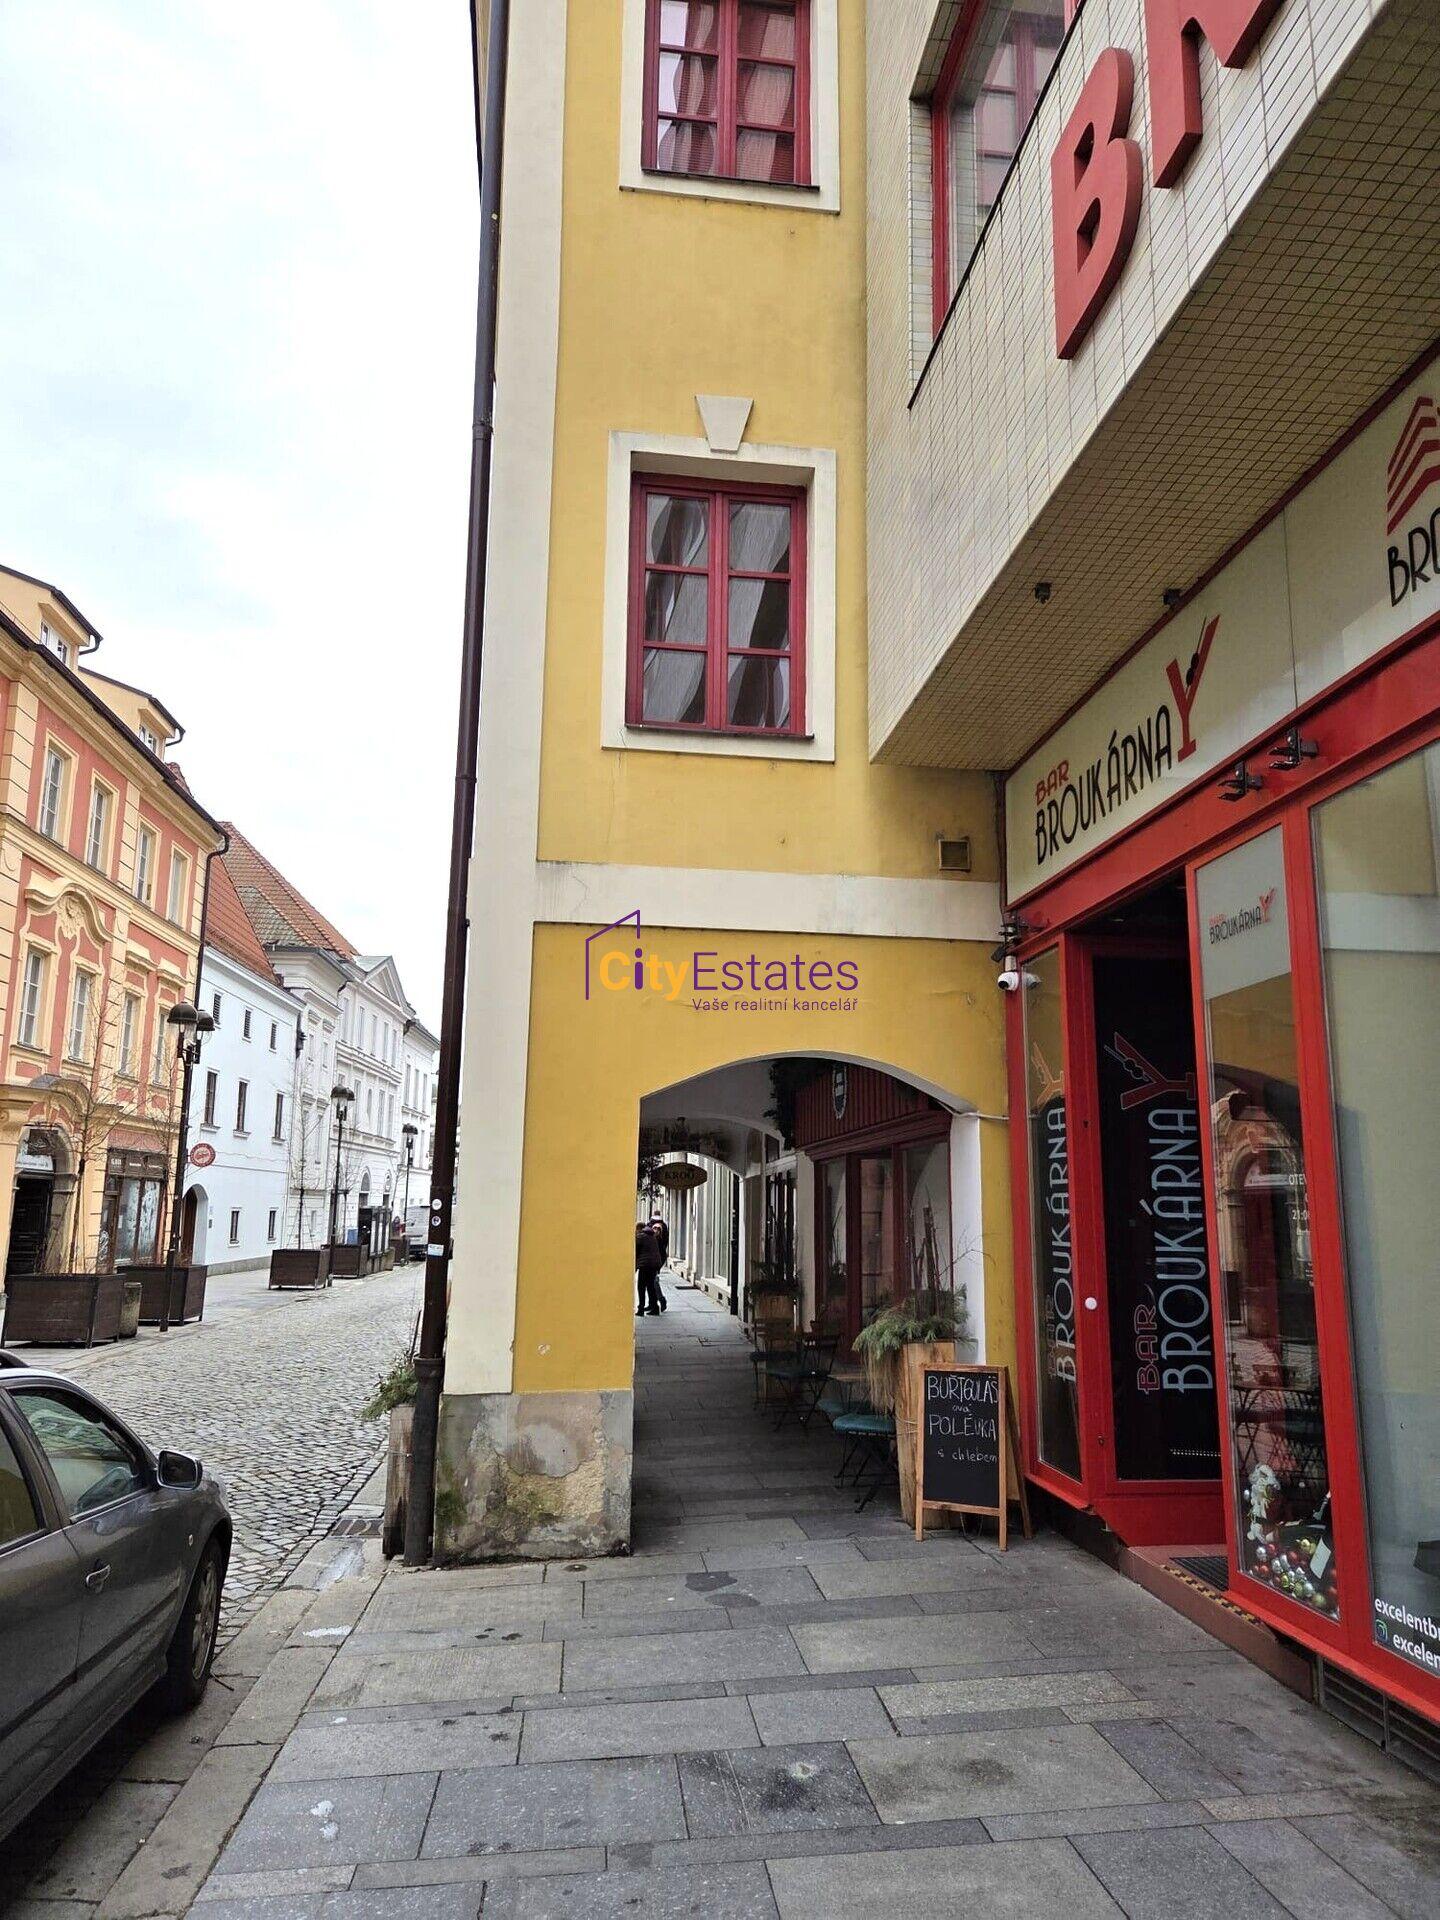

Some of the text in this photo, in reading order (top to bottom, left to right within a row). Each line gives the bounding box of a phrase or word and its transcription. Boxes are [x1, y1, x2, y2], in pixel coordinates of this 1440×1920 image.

[1035, 759, 1070, 806] BAR
[1133, 1303, 1160, 1395] BAR
[928, 1413, 997, 1441] POLÉVKA
[951, 1446, 998, 1463] chlebem
[1374, 1598, 1440, 1641] excelentb
